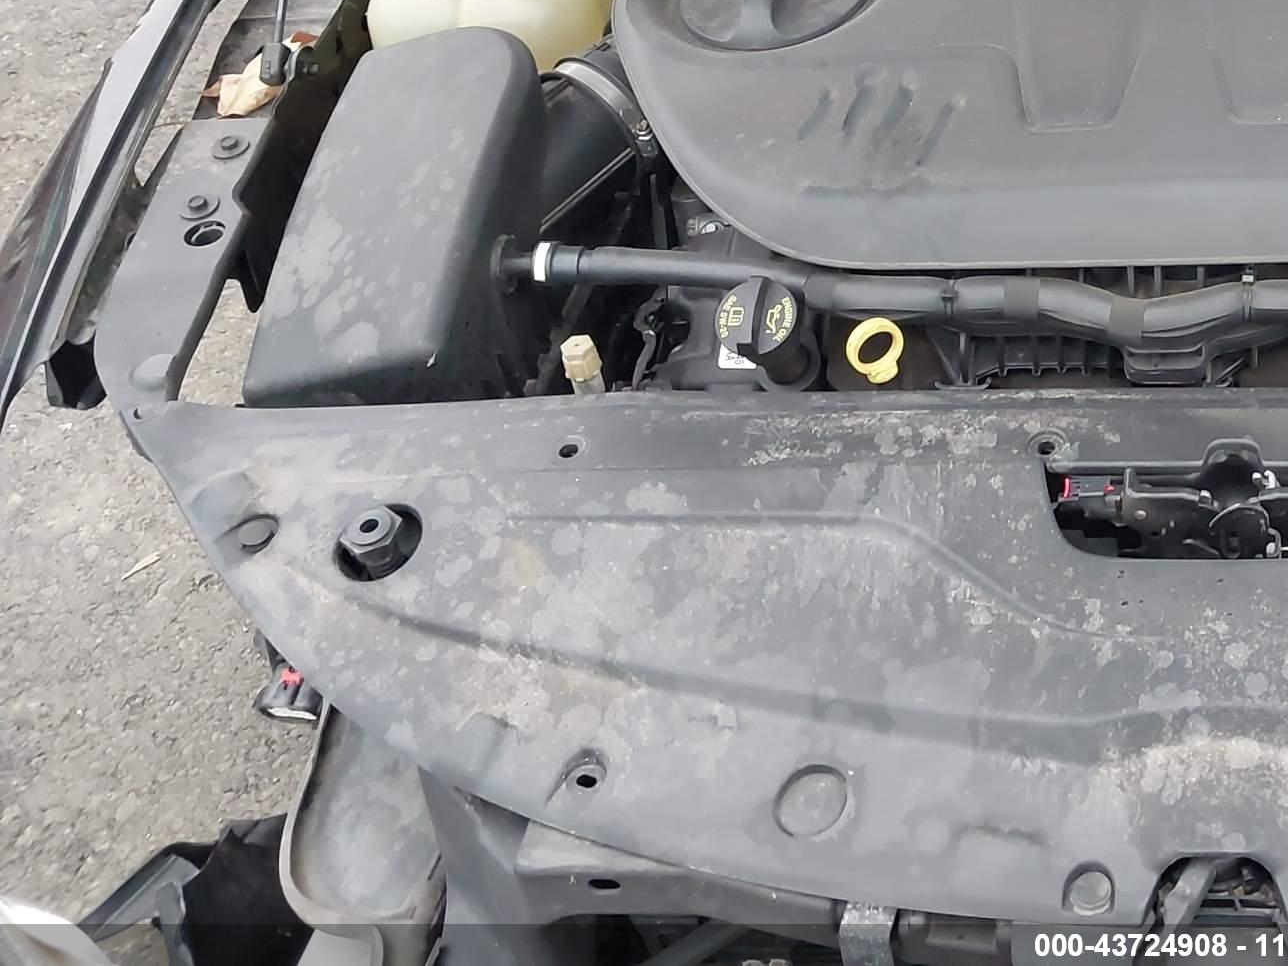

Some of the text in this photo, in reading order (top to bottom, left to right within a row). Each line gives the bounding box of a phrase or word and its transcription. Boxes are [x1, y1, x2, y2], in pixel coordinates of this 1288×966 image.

[719, 295, 737, 338] SAE 5W-20
[772, 296, 793, 342] ENGINE OIL
